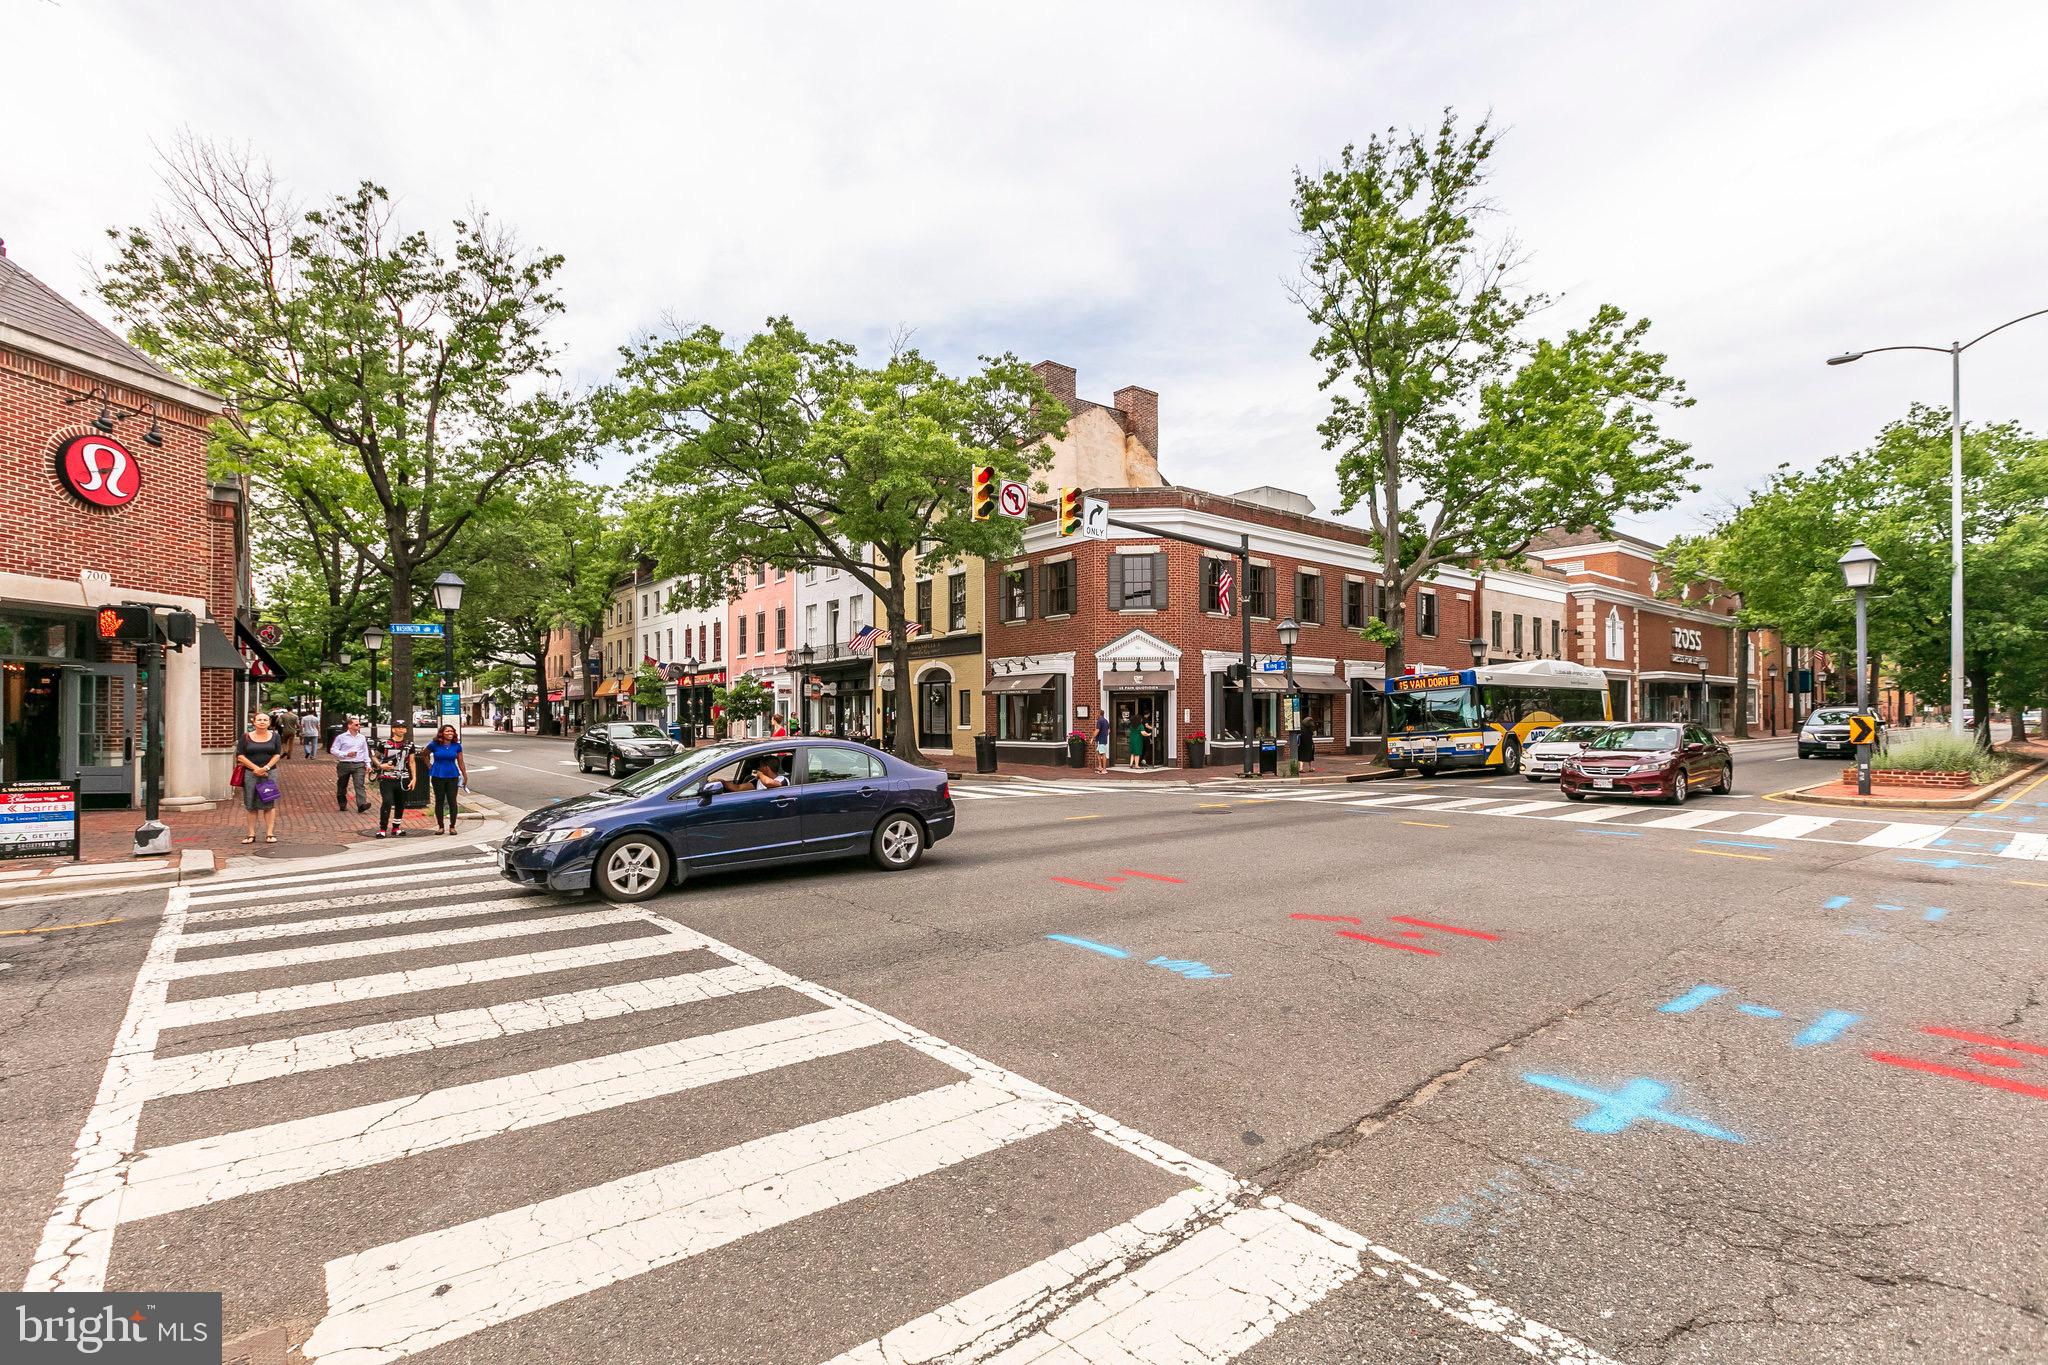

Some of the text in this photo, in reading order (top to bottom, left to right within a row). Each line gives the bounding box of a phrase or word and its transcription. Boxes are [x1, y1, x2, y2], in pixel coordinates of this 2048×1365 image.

[1086, 526, 1104, 537] ONLY
[87, 570, 107, 581] 700
[1672, 627, 1702, 650] ROSS
[1410, 679, 1426, 689] VAN
[1428, 677, 1449, 688] DORN
